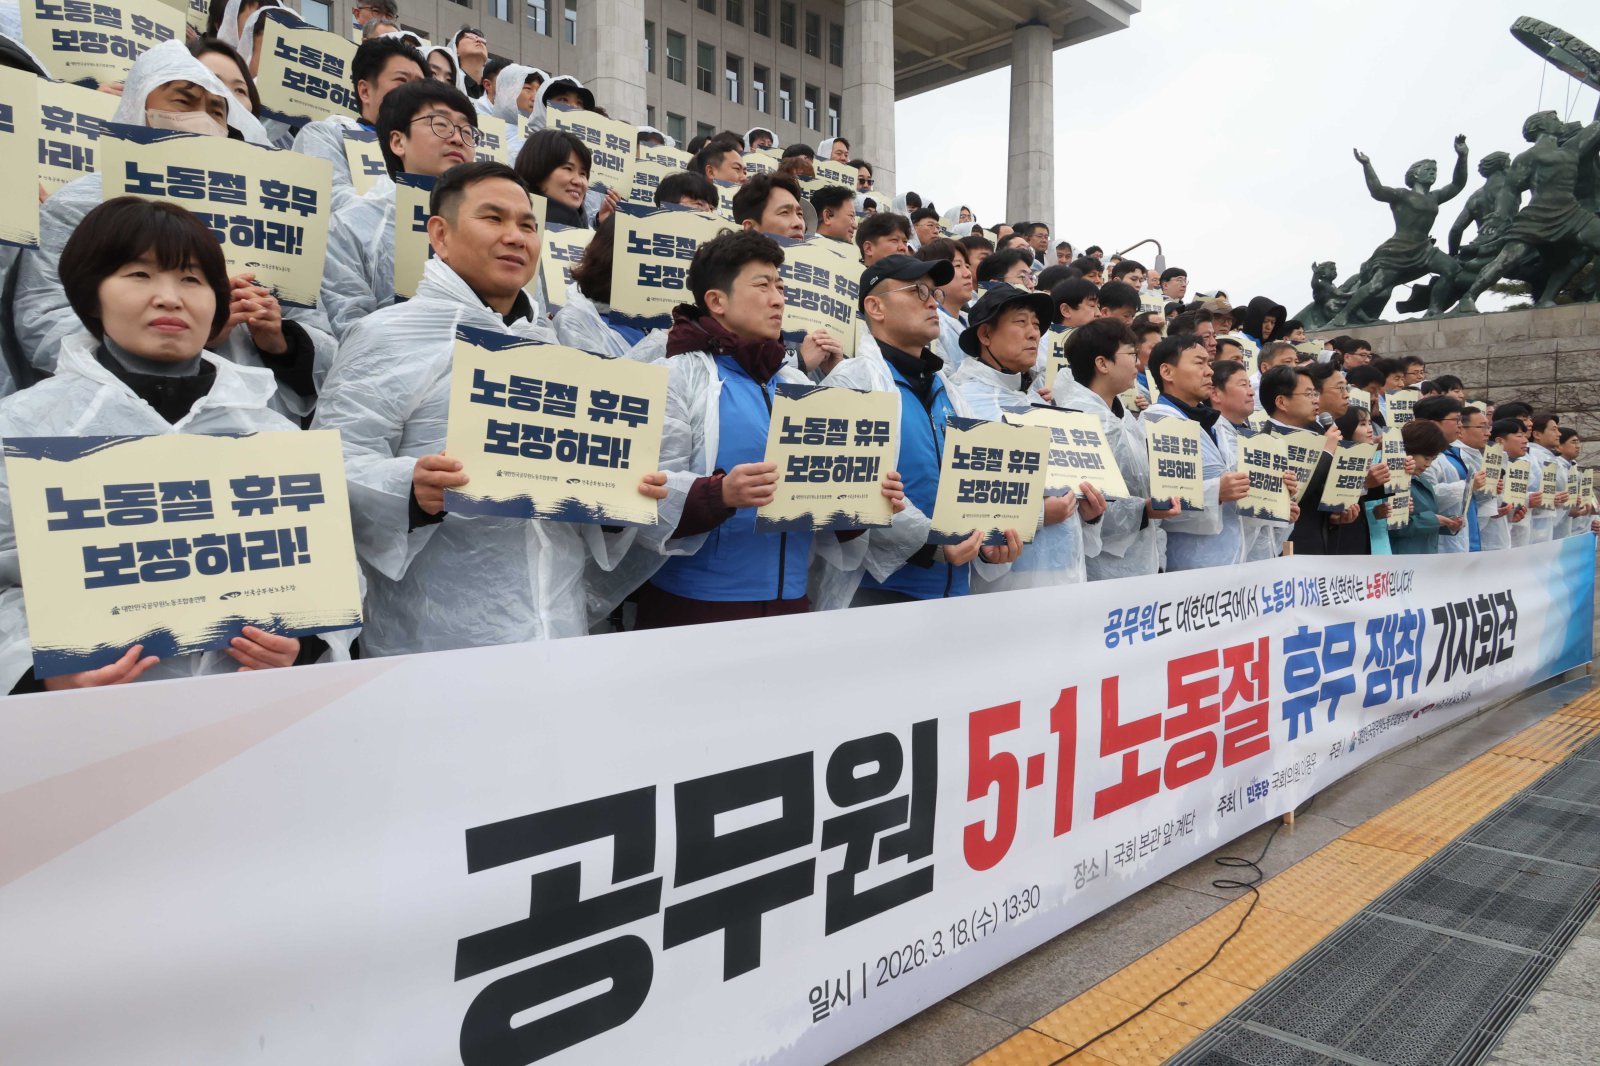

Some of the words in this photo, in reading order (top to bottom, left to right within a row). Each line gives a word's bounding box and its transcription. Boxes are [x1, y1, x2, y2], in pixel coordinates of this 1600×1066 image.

[274, 37, 344, 79] 노동절
[605, 133, 631, 154] 휴무
[125, 161, 247, 206] 노동절
[260, 179, 317, 217] 휴무
[627, 230, 696, 260] 노동절
[470, 368, 578, 418] 노동절
[588, 389, 649, 428] 휴무
[484, 419, 632, 469] 보장하라!
[779, 416, 849, 446] 노동절
[854, 419, 890, 447] 휴무
[1070, 429, 1101, 447] 휴무
[1152, 433, 1180, 455] 노동절
[1182, 436, 1198, 457] 휴무
[784, 454, 880, 483] 보장하라!
[952, 445, 1003, 472] 노동절
[1007, 449, 1041, 475] 휴무
[1158, 458, 1196, 480] 보장하라!
[1244, 447, 1271, 468] 노동절
[1336, 455, 1366, 471] 노동절
[956, 479, 1029, 505] 보장하라!
[1249, 470, 1282, 493] 보장하라!
[45, 480, 214, 531] 노동절
[229, 473, 325, 517] 휴무
[82, 526, 311, 590] 보장하라!
[1104, 601, 1172, 649] 공무원도
[1176, 585, 1259, 632] 대한민국에서
[1262, 577, 1295, 615] 노동의
[1298, 577, 1326, 607] 가치를
[1329, 574, 1365, 605] 실현하는
[1366, 569, 1415, 599] 노동자입니다!
[1217, 789, 1236, 818] 주최
[1246, 779, 1270, 804] 민주당
[454, 718, 939, 1066] 공무원
[1093, 636, 1270, 819] 노동절
[1282, 621, 1356, 742] 휴무
[1362, 608, 1426, 708] 쟁취
[1425, 589, 1518, 687] 기자회견
[1074, 857, 1100, 890] 장소
[1113, 836, 1137, 867] 국회
[1139, 825, 1161, 858] 본관
[1163, 820, 1174, 846] 앞
[1175, 809, 1196, 836] 계단
[808, 969, 851, 1024] 일시
[876, 939, 928, 987] 2026.
[932, 930, 946, 957] 3.
[1002, 884, 1041, 923] 13:30
